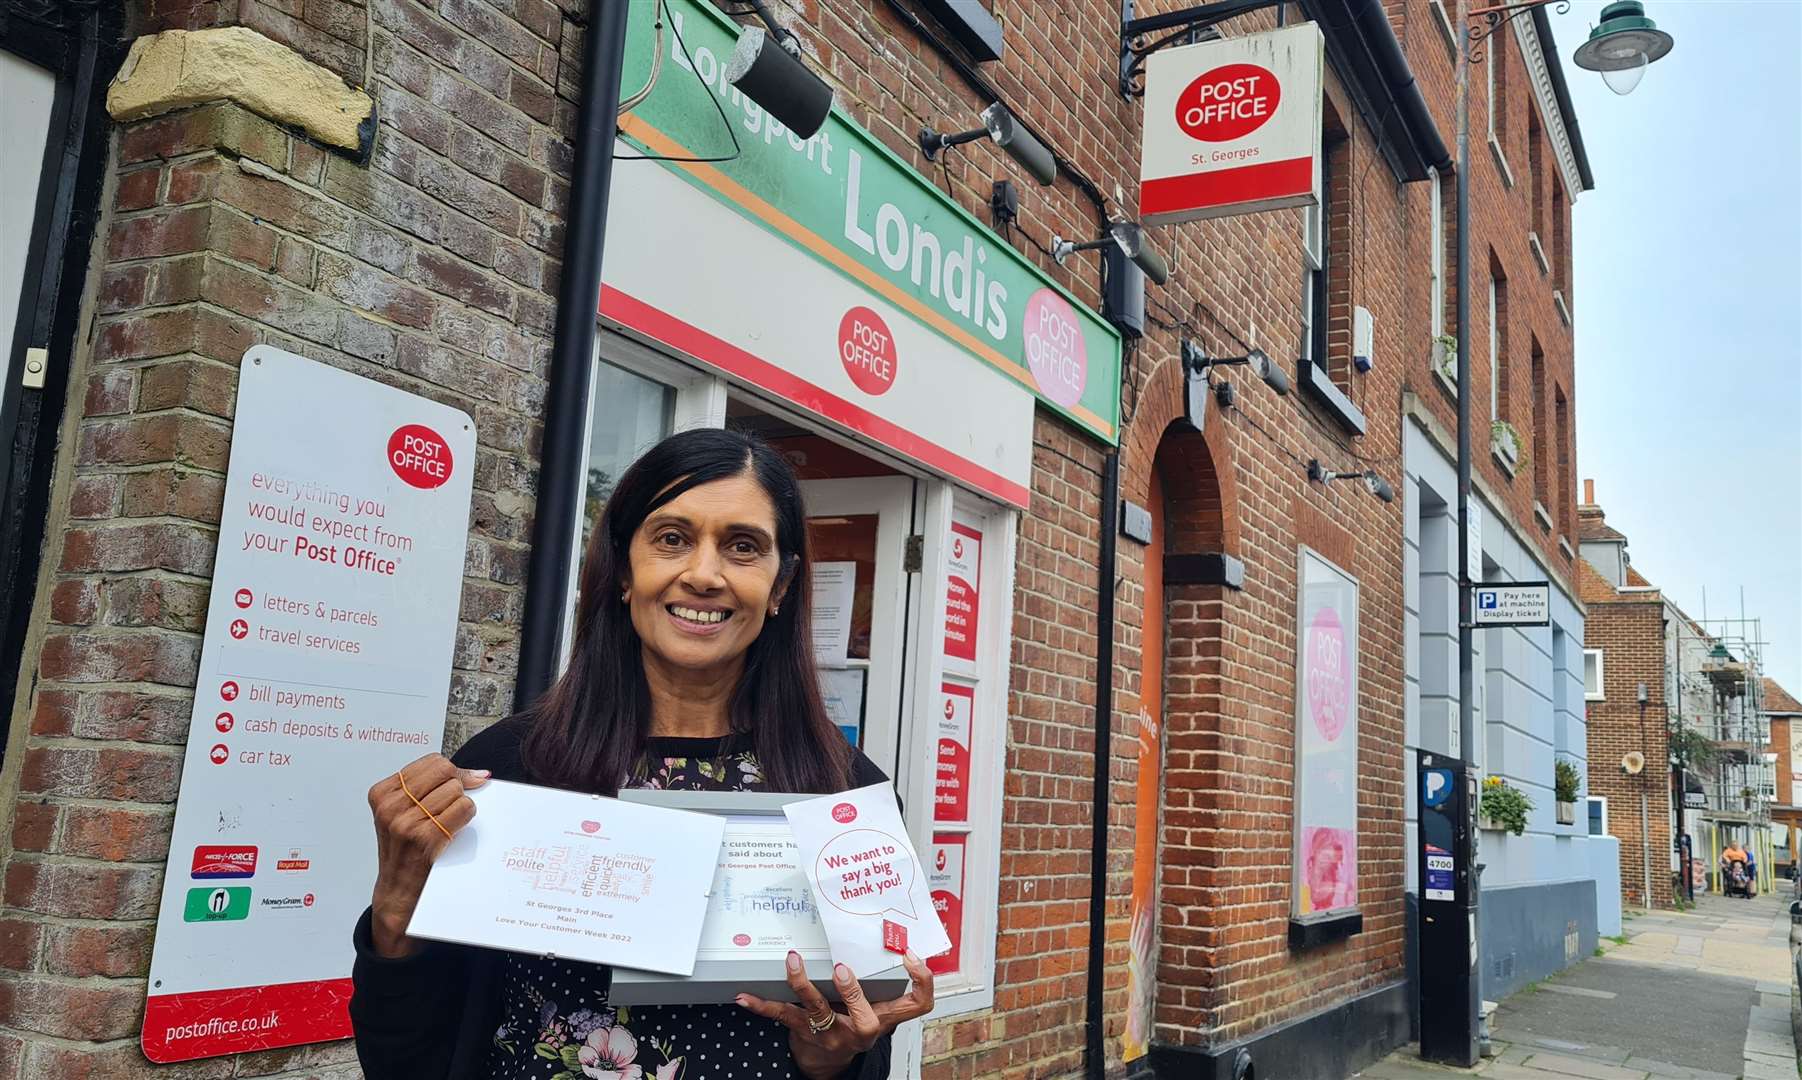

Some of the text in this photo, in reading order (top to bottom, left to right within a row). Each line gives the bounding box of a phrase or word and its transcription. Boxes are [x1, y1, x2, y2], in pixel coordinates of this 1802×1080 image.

[1200, 76, 1260, 104] POST
[1185, 97, 1267, 127] OFFICE
[1191, 146, 1260, 165] St. Georges
[844, 148, 1007, 340] Londis
[853, 320, 888, 354] POST
[1040, 304, 1077, 353] POST
[843, 340, 890, 381] OFFICE
[1029, 332, 1080, 391] OFFICE
[404, 434, 442, 459] POST
[393, 450, 445, 478] OFFICE
[252, 472, 385, 518] everything you
[249, 501, 413, 552] would expect from
[243, 531, 288, 553] your
[295, 536, 336, 564] Post
[263, 592, 378, 627] letters & parcels
[1482, 593, 1495, 608] P
[1504, 592, 1519, 600] Pay
[1483, 610, 1513, 618] Display
[259, 626, 360, 654] travel services
[1318, 631, 1342, 673] POST
[249, 684, 345, 710] bill payments
[244, 718, 430, 745] cash deposits & withdrawals
[239, 749, 292, 766] car tax
[940, 745, 956, 756] Send
[1427, 772, 1445, 800] P
[836, 805, 851, 813] POST
[511, 846, 546, 859] staff
[729, 841, 783, 849] customers
[753, 850, 783, 858] about
[824, 846, 895, 869] We want to
[506, 858, 544, 871] polite
[581, 854, 603, 897] efficient
[602, 856, 651, 874] friendly
[842, 861, 893, 883] say a big
[1429, 859, 1452, 869] 4700
[597, 890, 641, 903] extremely
[840, 873, 902, 900] thank you!
[538, 901, 572, 913] Georges
[574, 907, 589, 916] 3rd
[591, 911, 613, 920] Place
[752, 899, 805, 913] helpful
[496, 916, 632, 943] Love Your Customer Week 2022
[556, 915, 577, 924] Main
[166, 1011, 280, 1044] postoffice.co.uk
